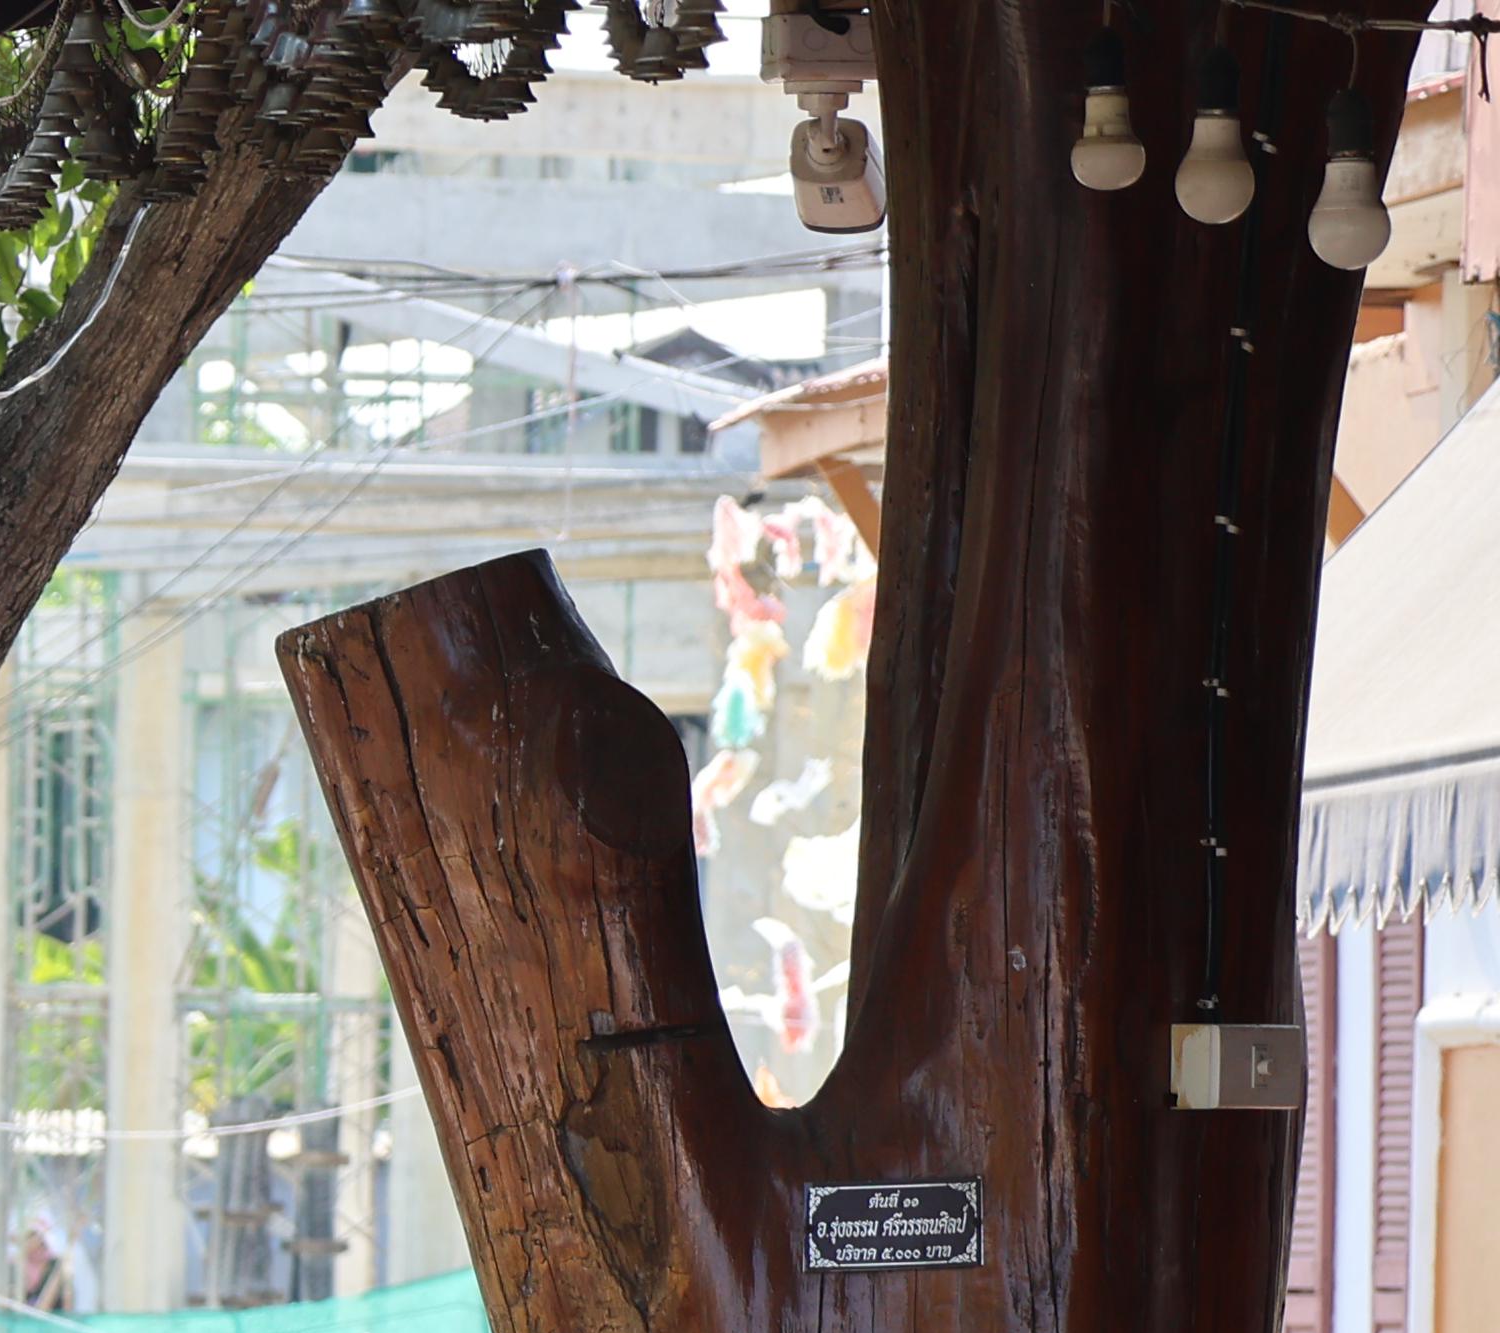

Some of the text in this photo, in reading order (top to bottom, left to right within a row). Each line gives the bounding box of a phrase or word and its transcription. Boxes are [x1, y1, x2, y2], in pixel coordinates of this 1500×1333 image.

[868, 1190, 900, 1208] ต้นที่
[817, 1216, 879, 1244] อ.รุ่งธรรม
[835, 1244, 877, 1261] บริจาค
[926, 1245, 952, 1258] บาท
